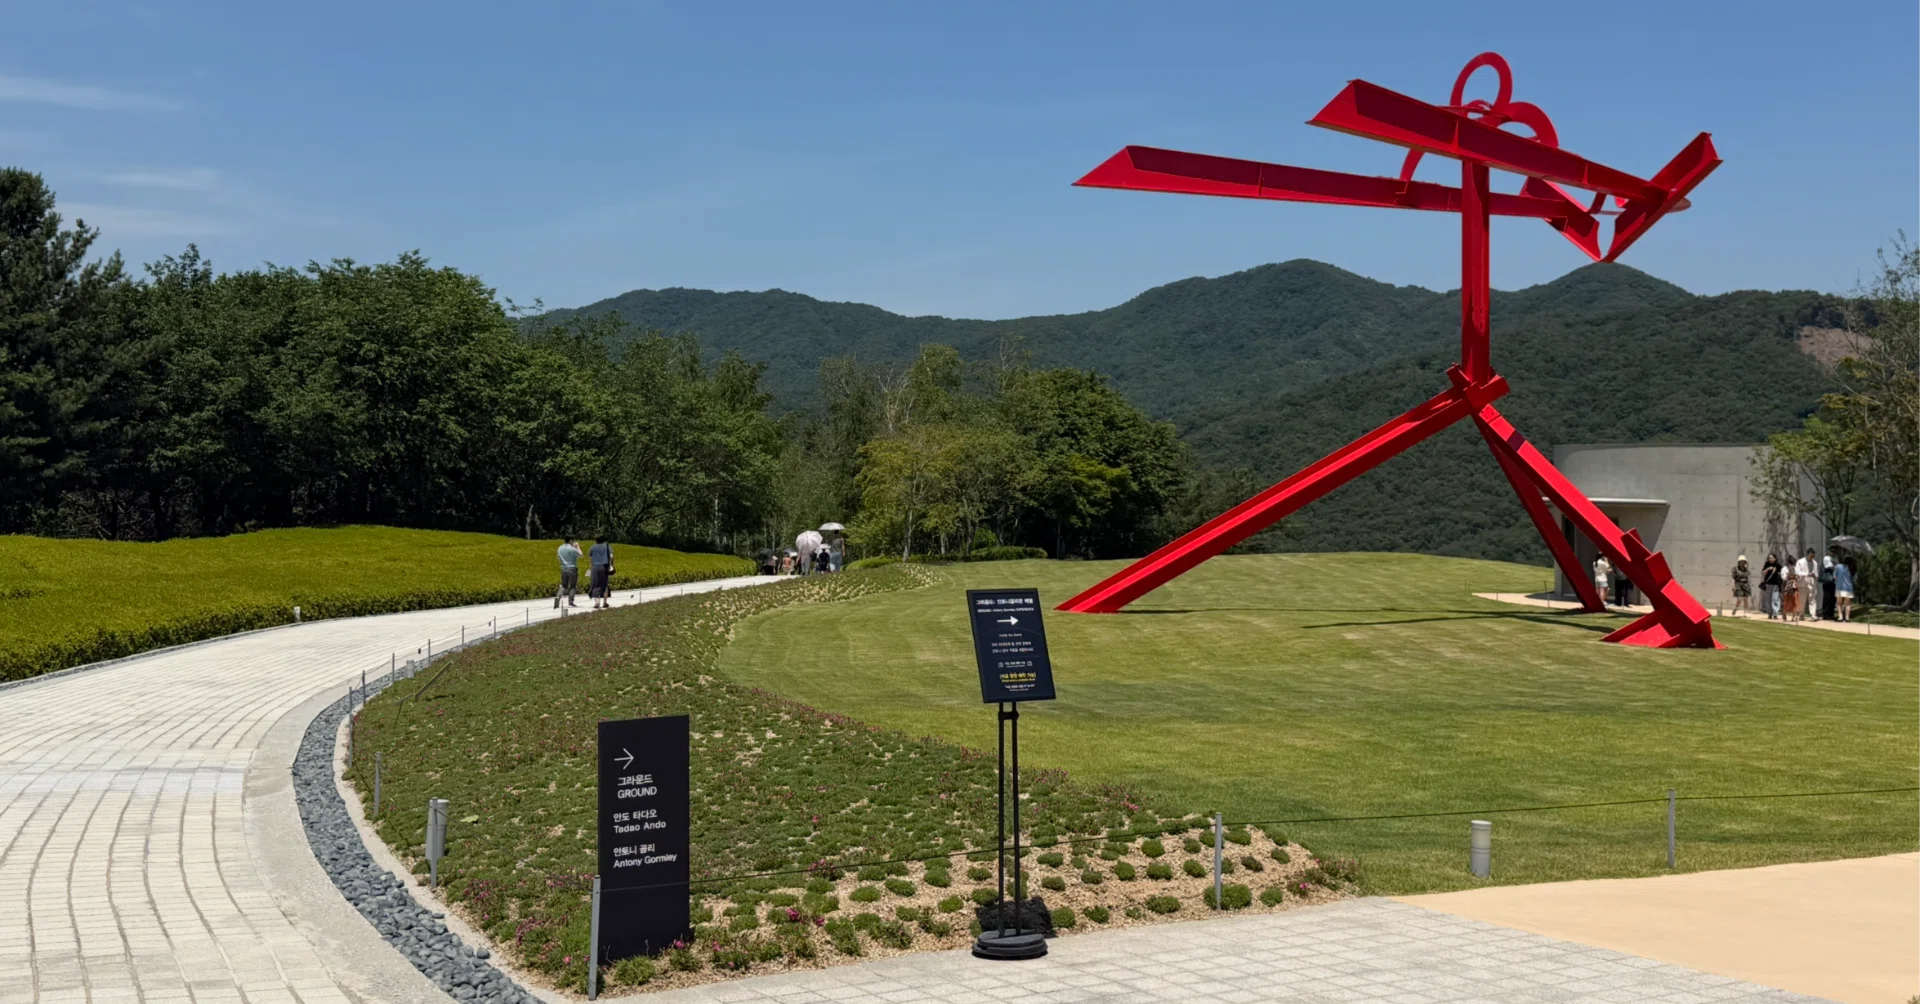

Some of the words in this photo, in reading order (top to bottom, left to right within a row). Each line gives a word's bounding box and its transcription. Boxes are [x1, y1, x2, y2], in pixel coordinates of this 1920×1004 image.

[617, 773, 654, 786] 그라운드
[617, 786, 658, 799] GROUND
[613, 812, 631, 823] 안도
[632, 809, 658, 820] 타다오
[613, 824, 641, 834] Tadao
[643, 820, 667, 830] Ando
[613, 845, 638, 857] 안토니
[639, 843, 656, 854] 곰리
[613, 857, 642, 868] Antony
[644, 853, 678, 865] Gormley
